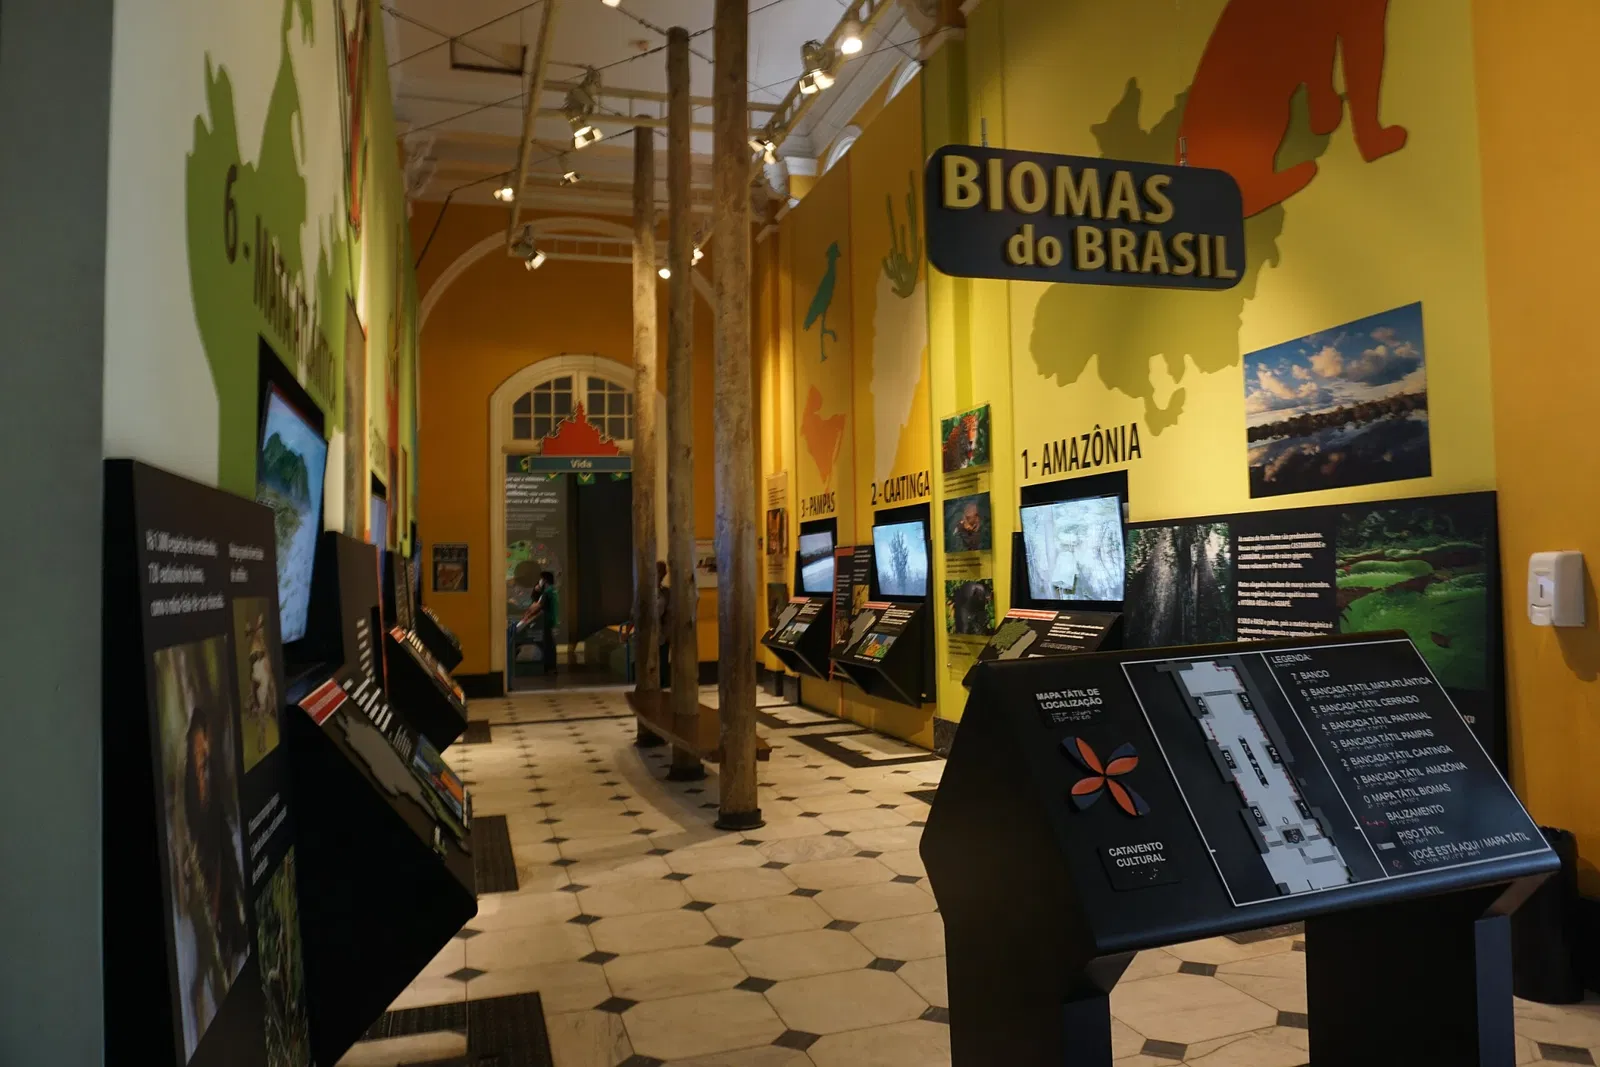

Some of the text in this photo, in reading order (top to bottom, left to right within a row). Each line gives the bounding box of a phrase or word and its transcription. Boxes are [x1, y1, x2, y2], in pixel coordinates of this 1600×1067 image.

[942, 154, 1175, 225] BIOMAS
[1006, 223, 1238, 280] do BRASIL
[1041, 422, 1142, 477] AMAZÔNIA
[570, 458, 593, 469] Vida
[884, 470, 931, 504] CAATINGA
[809, 491, 836, 517] PAMPAS
[1270, 653, 1312, 664] LEGENDA:
[1290, 669, 1330, 680] 7 BANCO
[1036, 691, 1062, 700] MAPA
[1086, 688, 1100, 696] DE
[1300, 688, 1308, 697] 6
[1309, 685, 1350, 696] BANCADA
[1370, 681, 1391, 690] MATA
[1040, 696, 1103, 710] LOCALIZAÇÃO
[1241, 694, 1248, 703] 3
[1310, 706, 1318, 714] 5
[1319, 701, 1360, 713] BANCADA
[1380, 694, 1420, 706] CERRADO
[1329, 718, 1370, 730] BANCADA
[1390, 712, 1433, 723] PANTANAL
[1330, 740, 1338, 748] 3
[1340, 736, 1380, 748] BANCADA
[1401, 728, 1434, 740] PAMPAS
[1224, 752, 1232, 761] 5
[1269, 747, 1278, 756] 2
[1341, 758, 1349, 767] 2
[1350, 754, 1390, 766] BANCADA
[1412, 744, 1454, 758] CAATINGA
[1354, 776, 1360, 784] 1
[1360, 771, 1402, 784] BANCADA
[1425, 762, 1468, 775] AMAZÔNIA
[1371, 792, 1398, 802] MAPA
[1418, 783, 1452, 796] BIOMAS
[1254, 808, 1261, 818] 6
[1300, 802, 1307, 810] 1
[1385, 804, 1445, 821] BALIZAMENTO
[1396, 829, 1420, 841] PISO
[1108, 841, 1164, 857] CATAVENTO
[1408, 846, 1436, 860] VOCÊ
[1434, 842, 1459, 856] ESTÁ
[1458, 840, 1481, 852] AQUI
[1482, 836, 1508, 848] MAPA
[1116, 853, 1166, 868] CULTURAL
